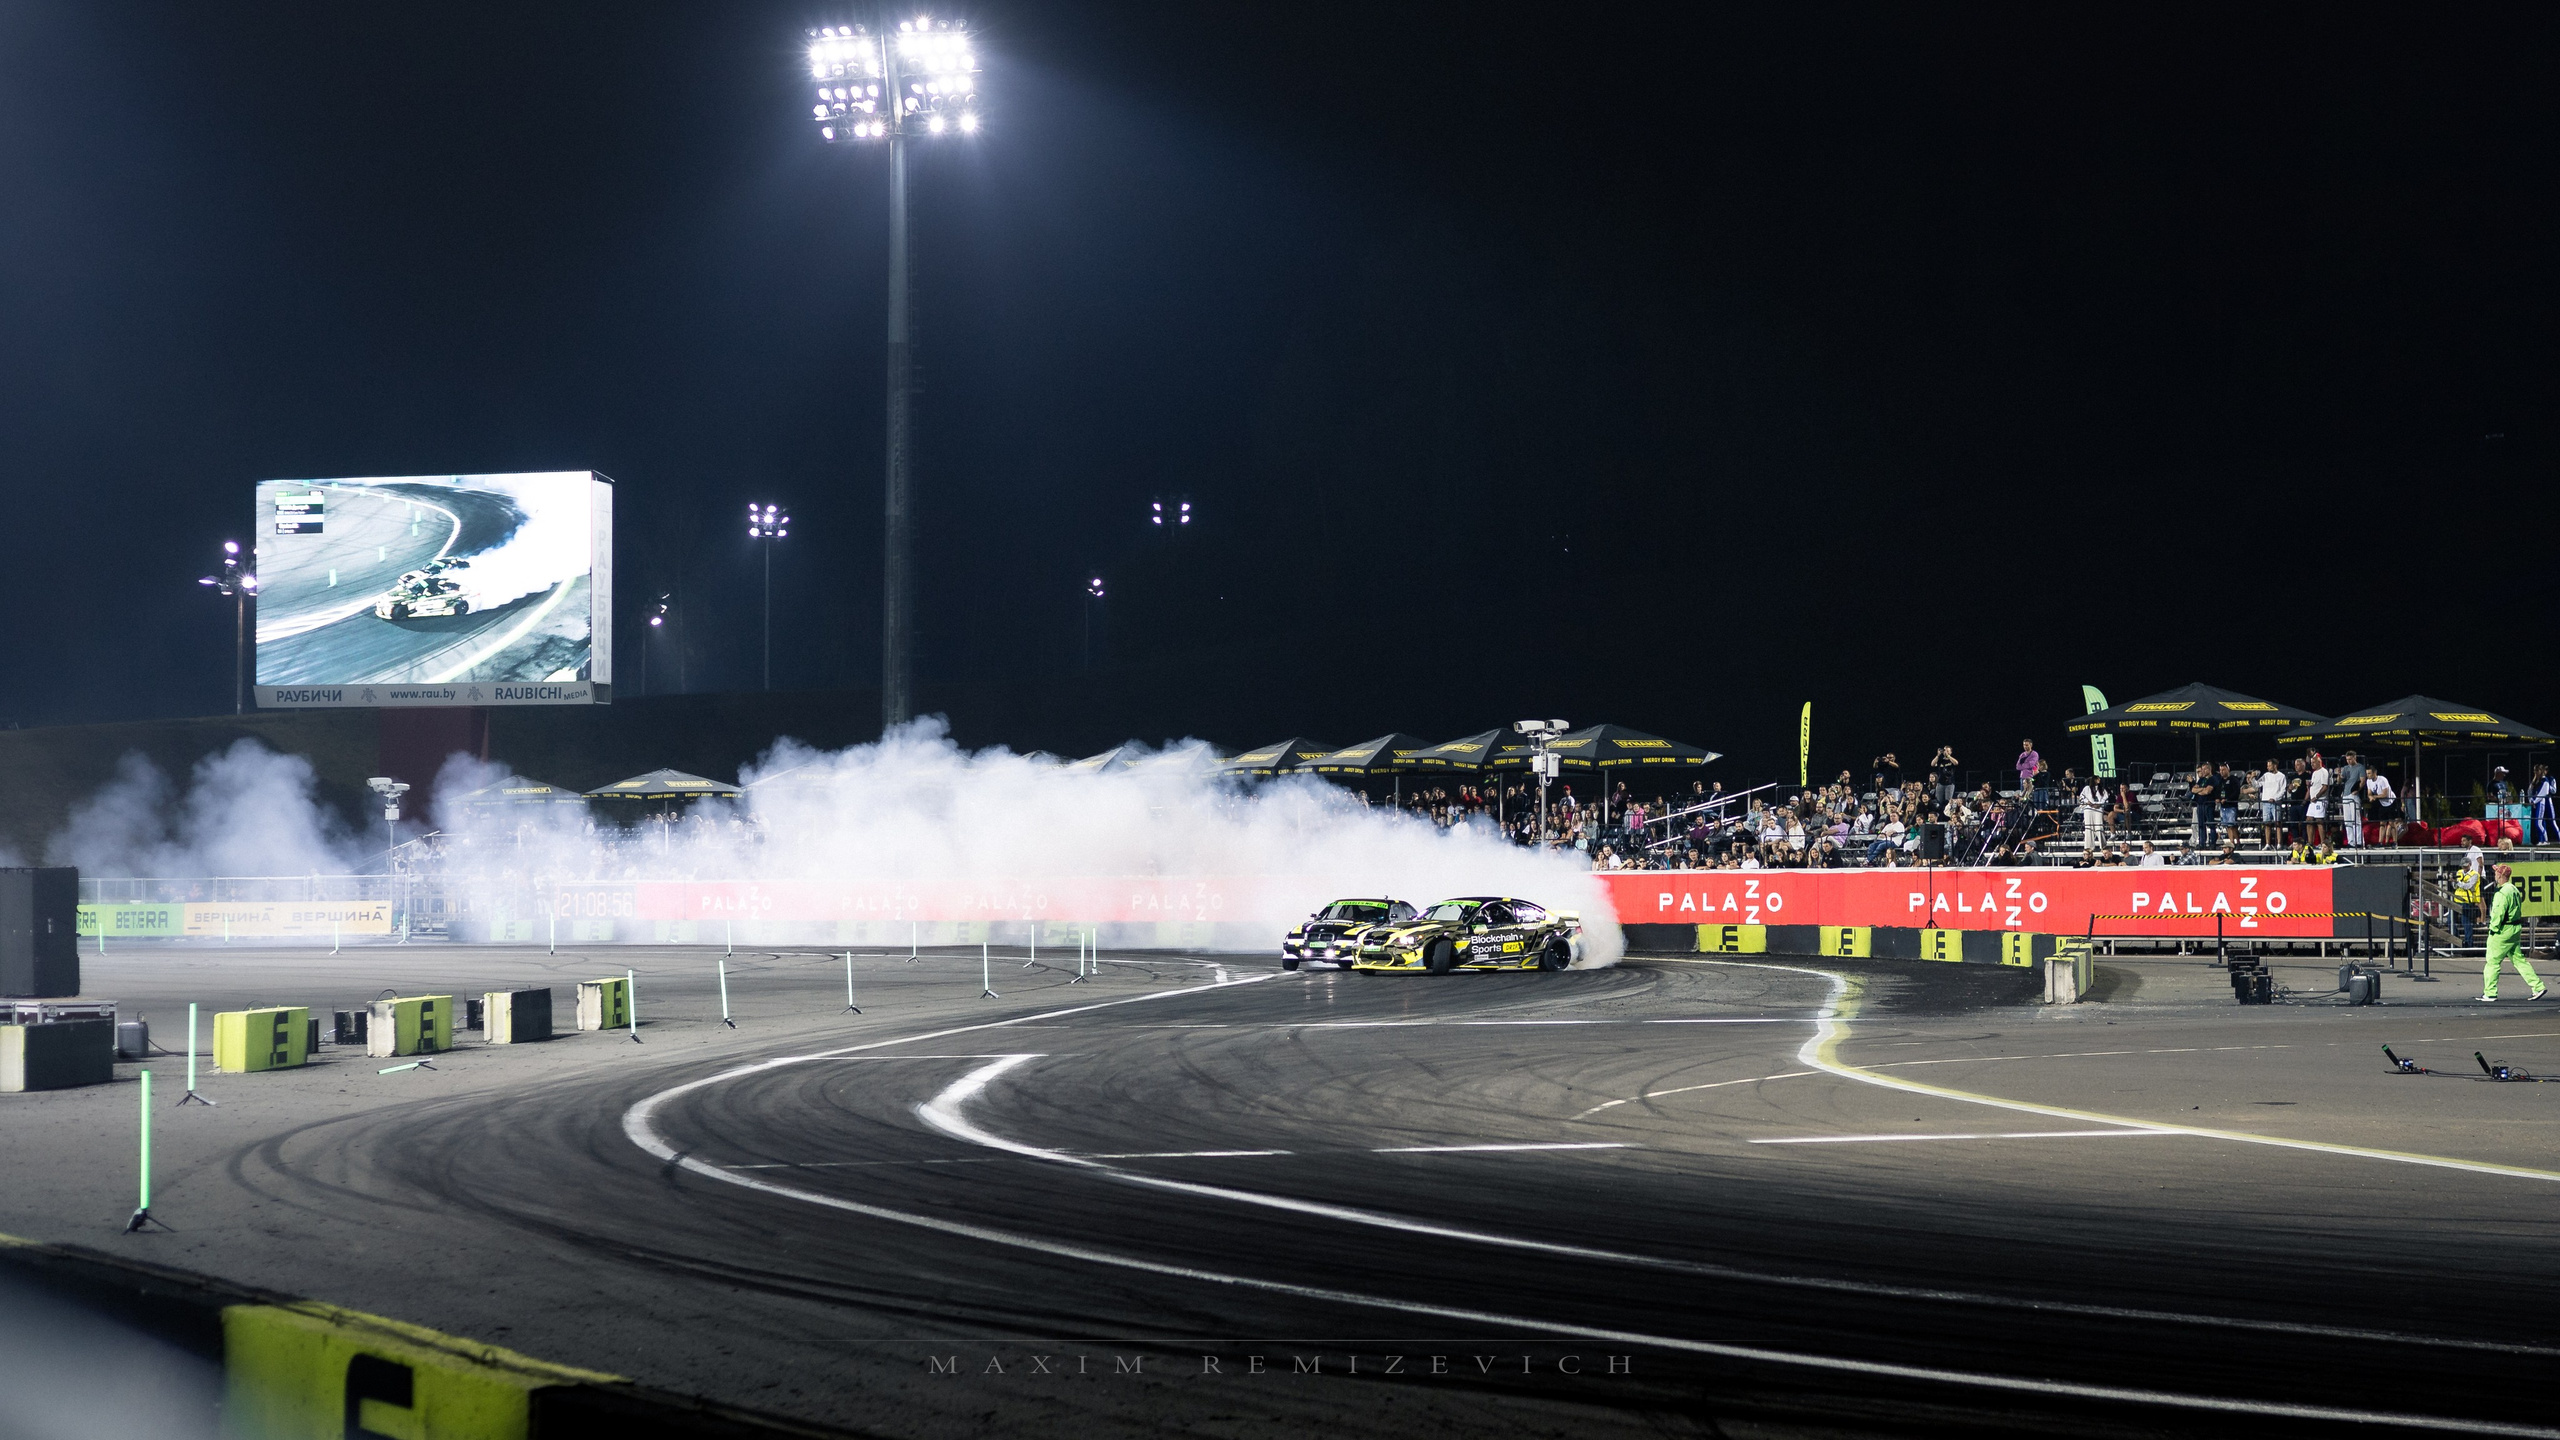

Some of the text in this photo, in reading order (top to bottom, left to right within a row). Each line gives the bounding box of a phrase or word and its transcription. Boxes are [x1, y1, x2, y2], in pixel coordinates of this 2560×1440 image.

[276, 690, 342, 702] РАУБИЧИ
[390, 688, 456, 700] www.rau.by
[495, 686, 588, 700] RAUBICHI MEDIA
[2069, 724, 2088, 732] ENERGY
[2218, 721, 2236, 729] ENERGY
[561, 892, 634, 918] 21:08:56
[1659, 880, 1783, 925] PALAZZO
[1909, 878, 2048, 926] PALAZZO
[2132, 878, 2288, 928] PALAZZO
[116, 911, 169, 929] BETERA
[292, 910, 384, 923] ВЕРШИНА
[1471, 932, 1519, 944] Blockchain
[1471, 944, 1502, 955] Sports
